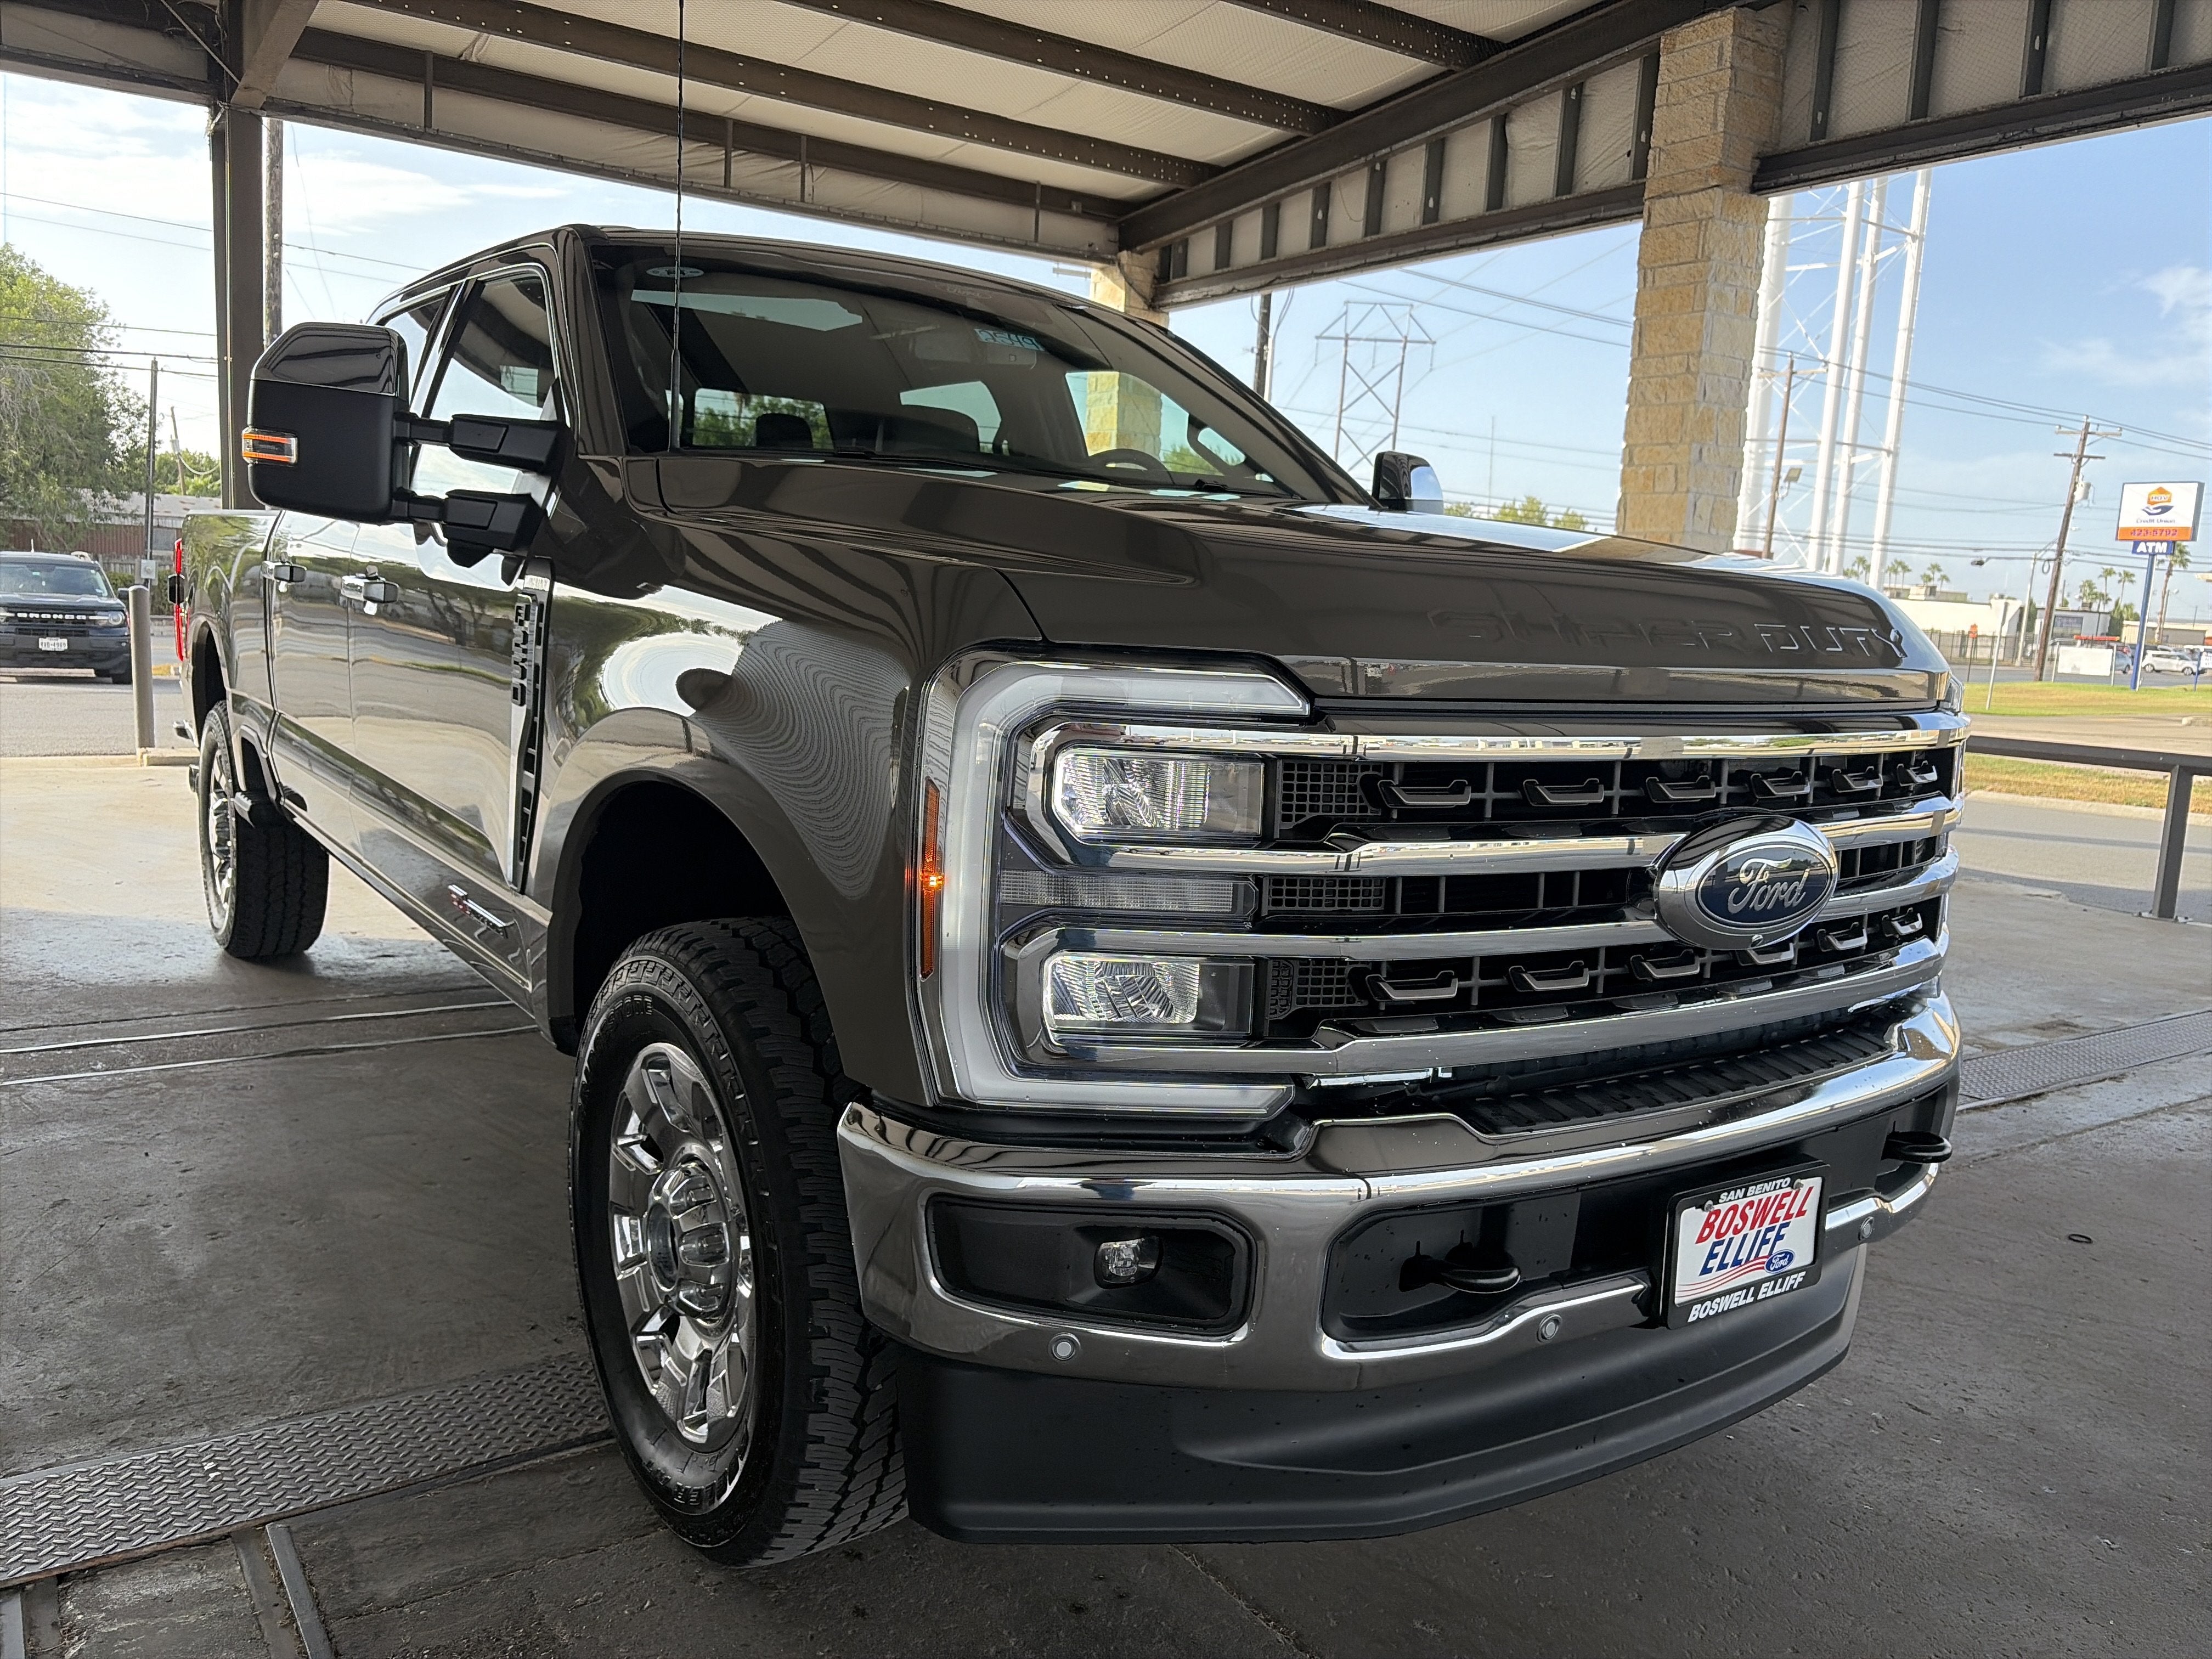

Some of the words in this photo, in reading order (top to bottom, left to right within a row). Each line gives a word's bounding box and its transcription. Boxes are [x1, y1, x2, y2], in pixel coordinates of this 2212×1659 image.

[979, 330, 1040, 350] 2549
[2136, 542, 2168, 553] ATM
[1754, 623, 1908, 658] DUTY
[1728, 857, 1810, 914] Ford
[1718, 1188, 1746, 1204] SAN
[1746, 1177, 1791, 1197] BENITO
[1695, 1186, 1814, 1244] BOSWELL
[1699, 1221, 1792, 1277] ELLIFF
[1770, 1253, 1790, 1271] Ford
[1687, 1286, 1755, 1323] BOSWELL
[1757, 1271, 1807, 1300] ELLIFF
